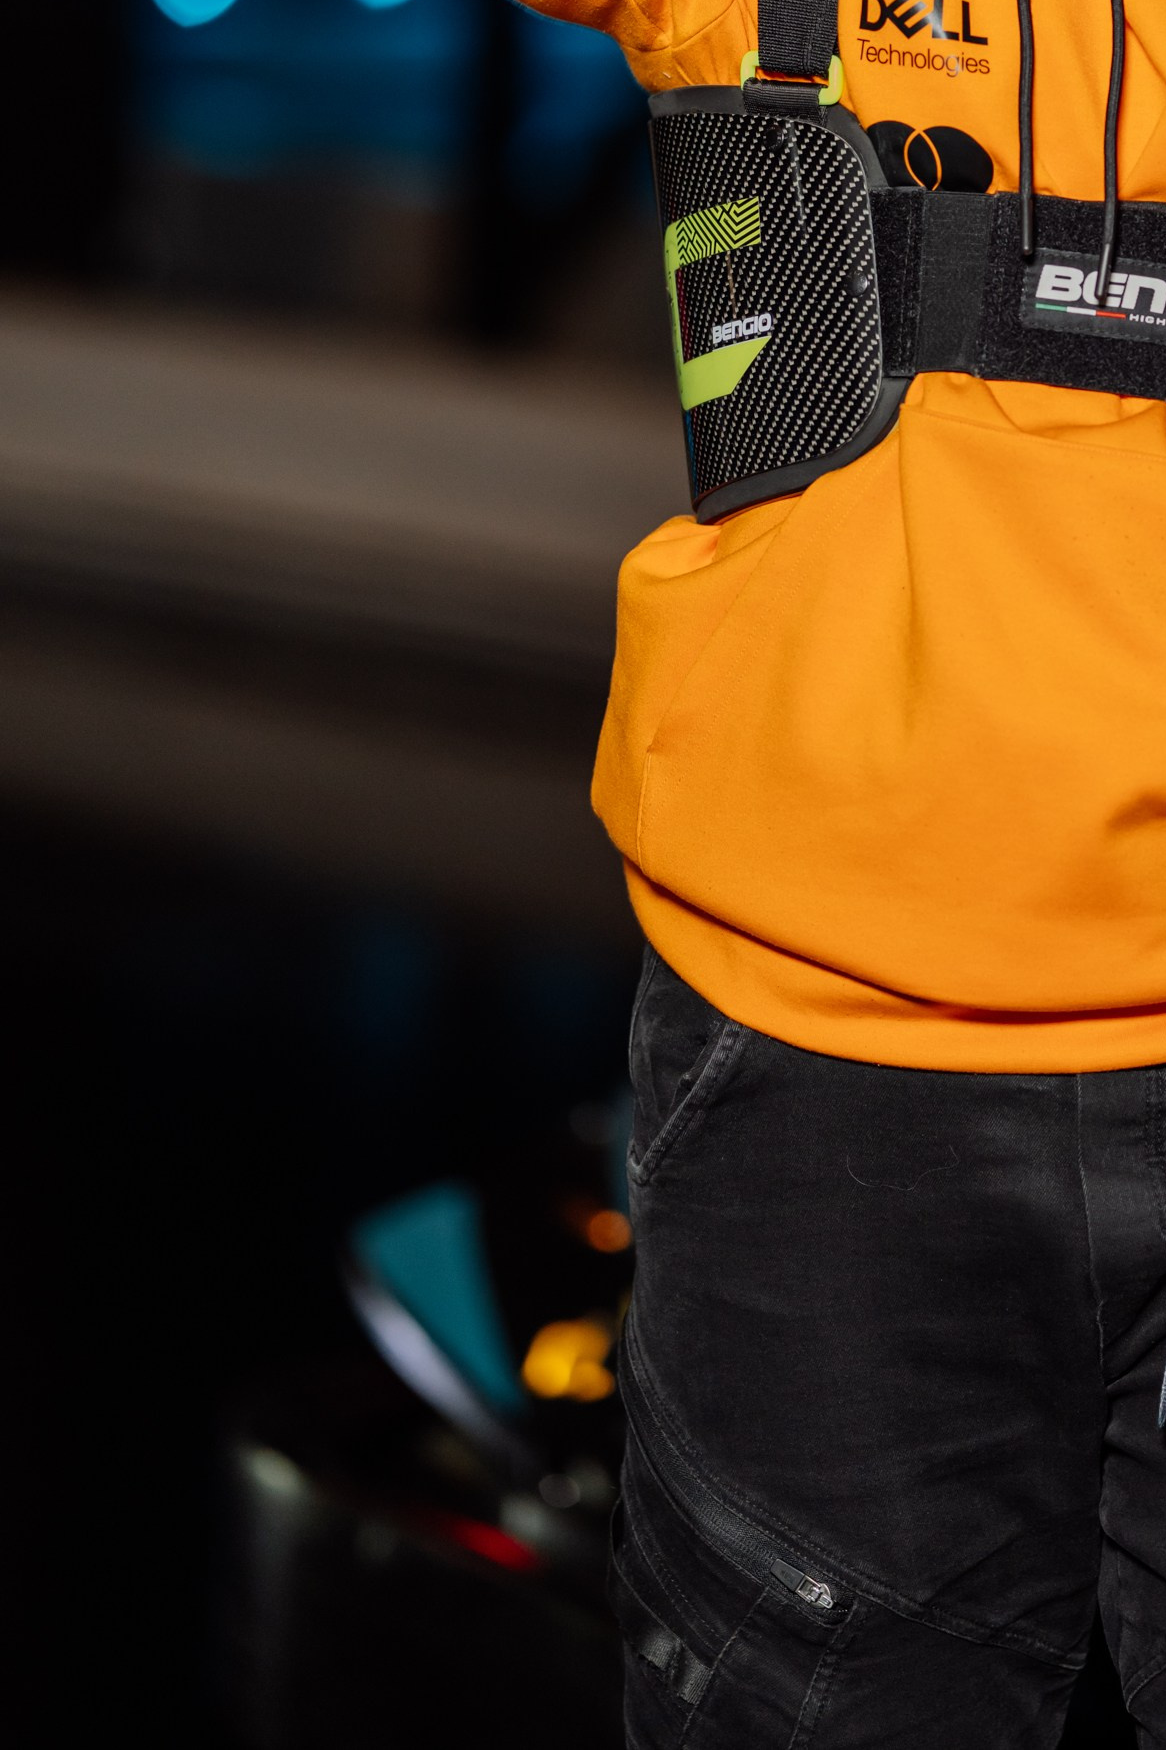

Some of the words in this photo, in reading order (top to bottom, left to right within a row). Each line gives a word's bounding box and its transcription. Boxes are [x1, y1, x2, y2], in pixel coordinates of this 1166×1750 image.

[857, 38, 991, 79] Technologies
[712, 312, 773, 345] BENGIO
[1129, 313, 1166, 327] HIGH
